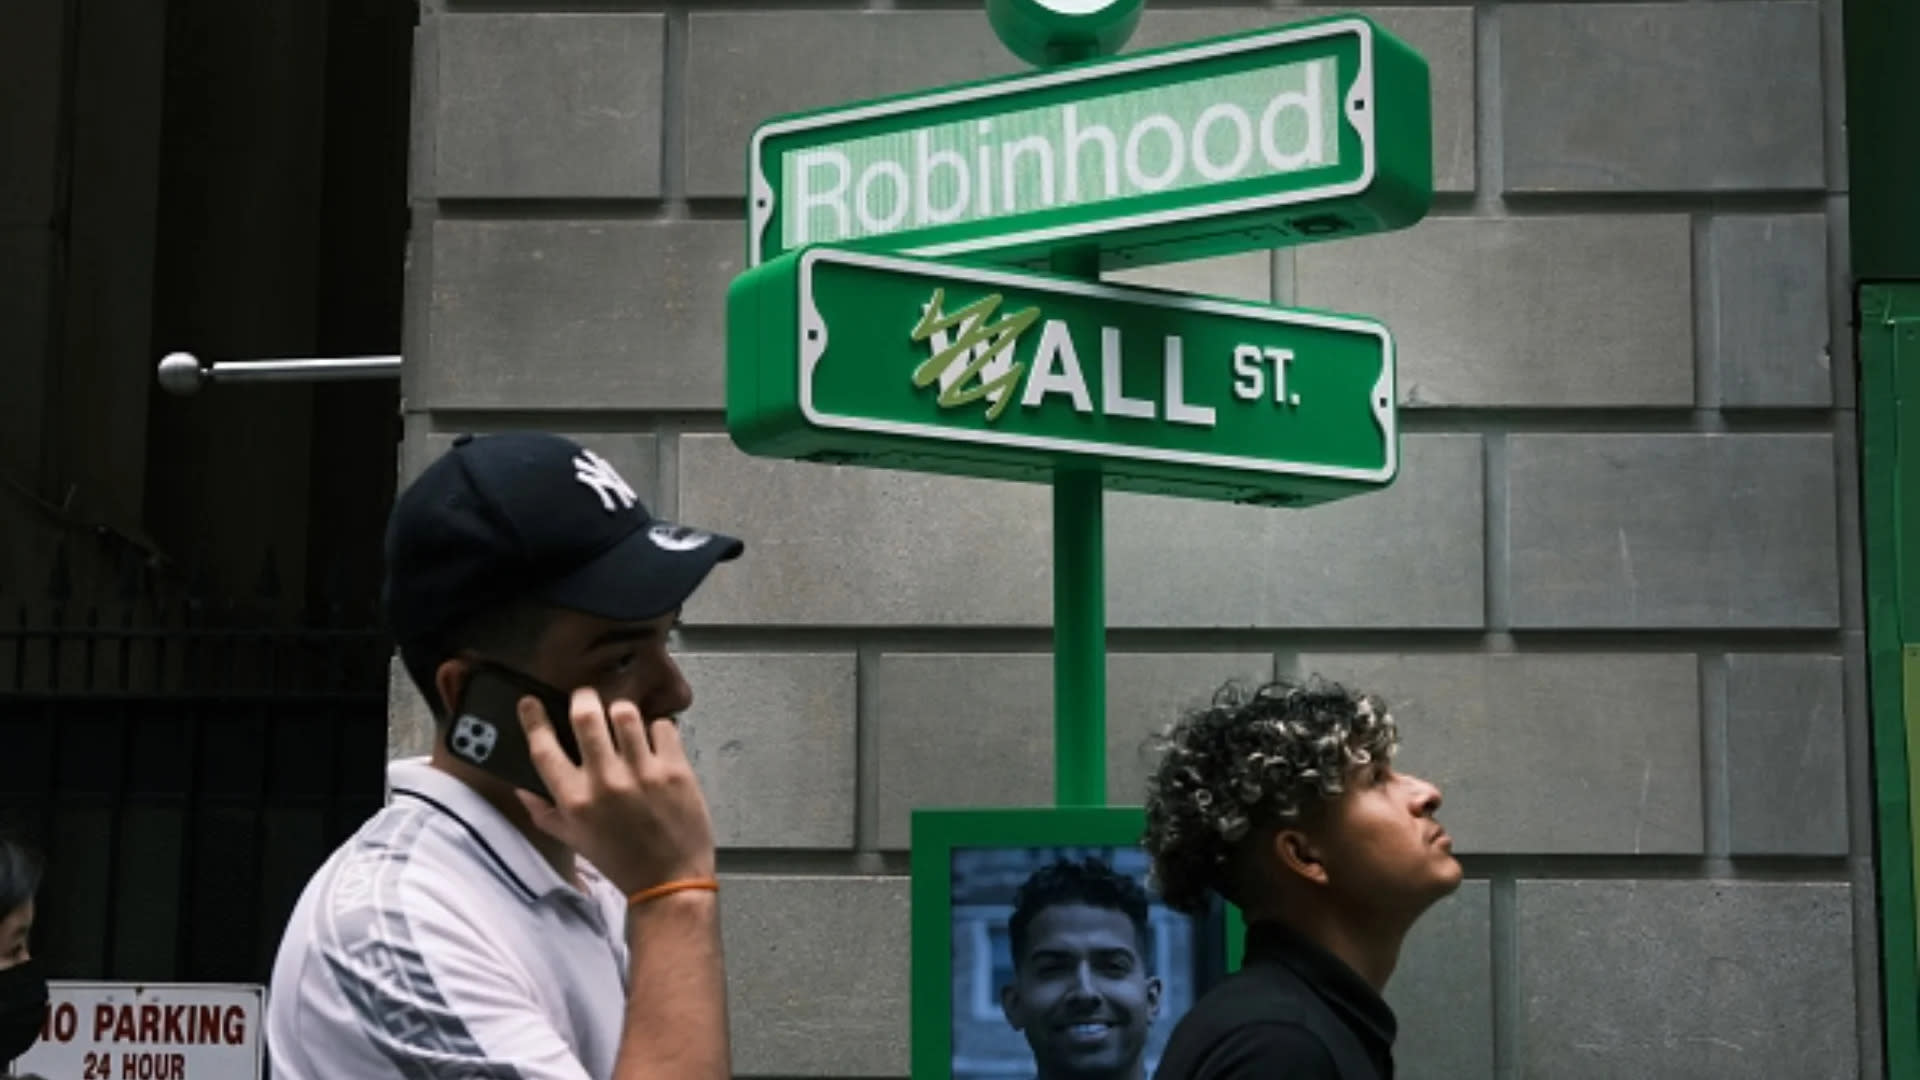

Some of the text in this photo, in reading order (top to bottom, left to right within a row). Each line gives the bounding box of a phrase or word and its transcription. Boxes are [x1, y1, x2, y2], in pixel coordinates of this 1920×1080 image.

[799, 60, 1323, 241] Robinhood
[1232, 345, 1300, 406] ST.
[94, 1004, 245, 1045] PARKING
[84, 1051, 185, 1080] 24 HOUR
